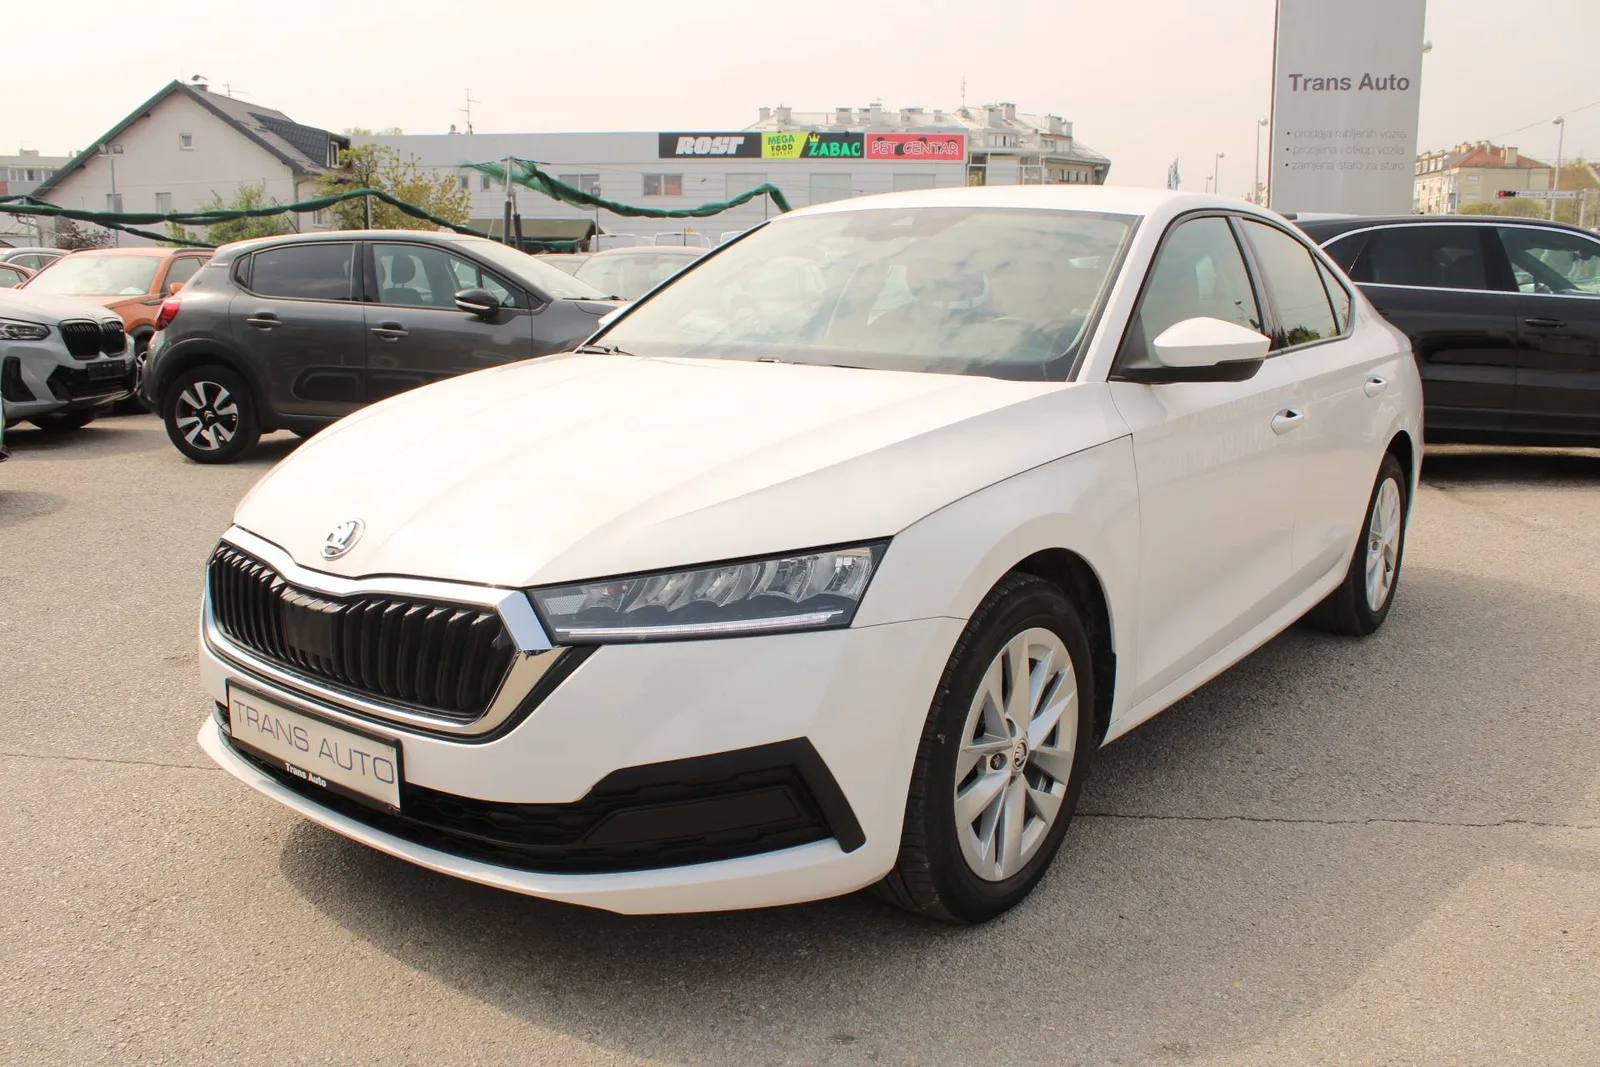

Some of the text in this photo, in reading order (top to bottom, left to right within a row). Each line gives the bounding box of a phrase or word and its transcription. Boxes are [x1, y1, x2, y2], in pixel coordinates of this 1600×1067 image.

[1288, 73, 1410, 91] Trans Auto
[768, 134, 795, 145] MEGA
[771, 144, 793, 152] FOOD
[872, 141, 959, 155] PET CENTAR
[233, 699, 395, 784] TRANS AUTO
[285, 762, 327, 788] Trans Auto
